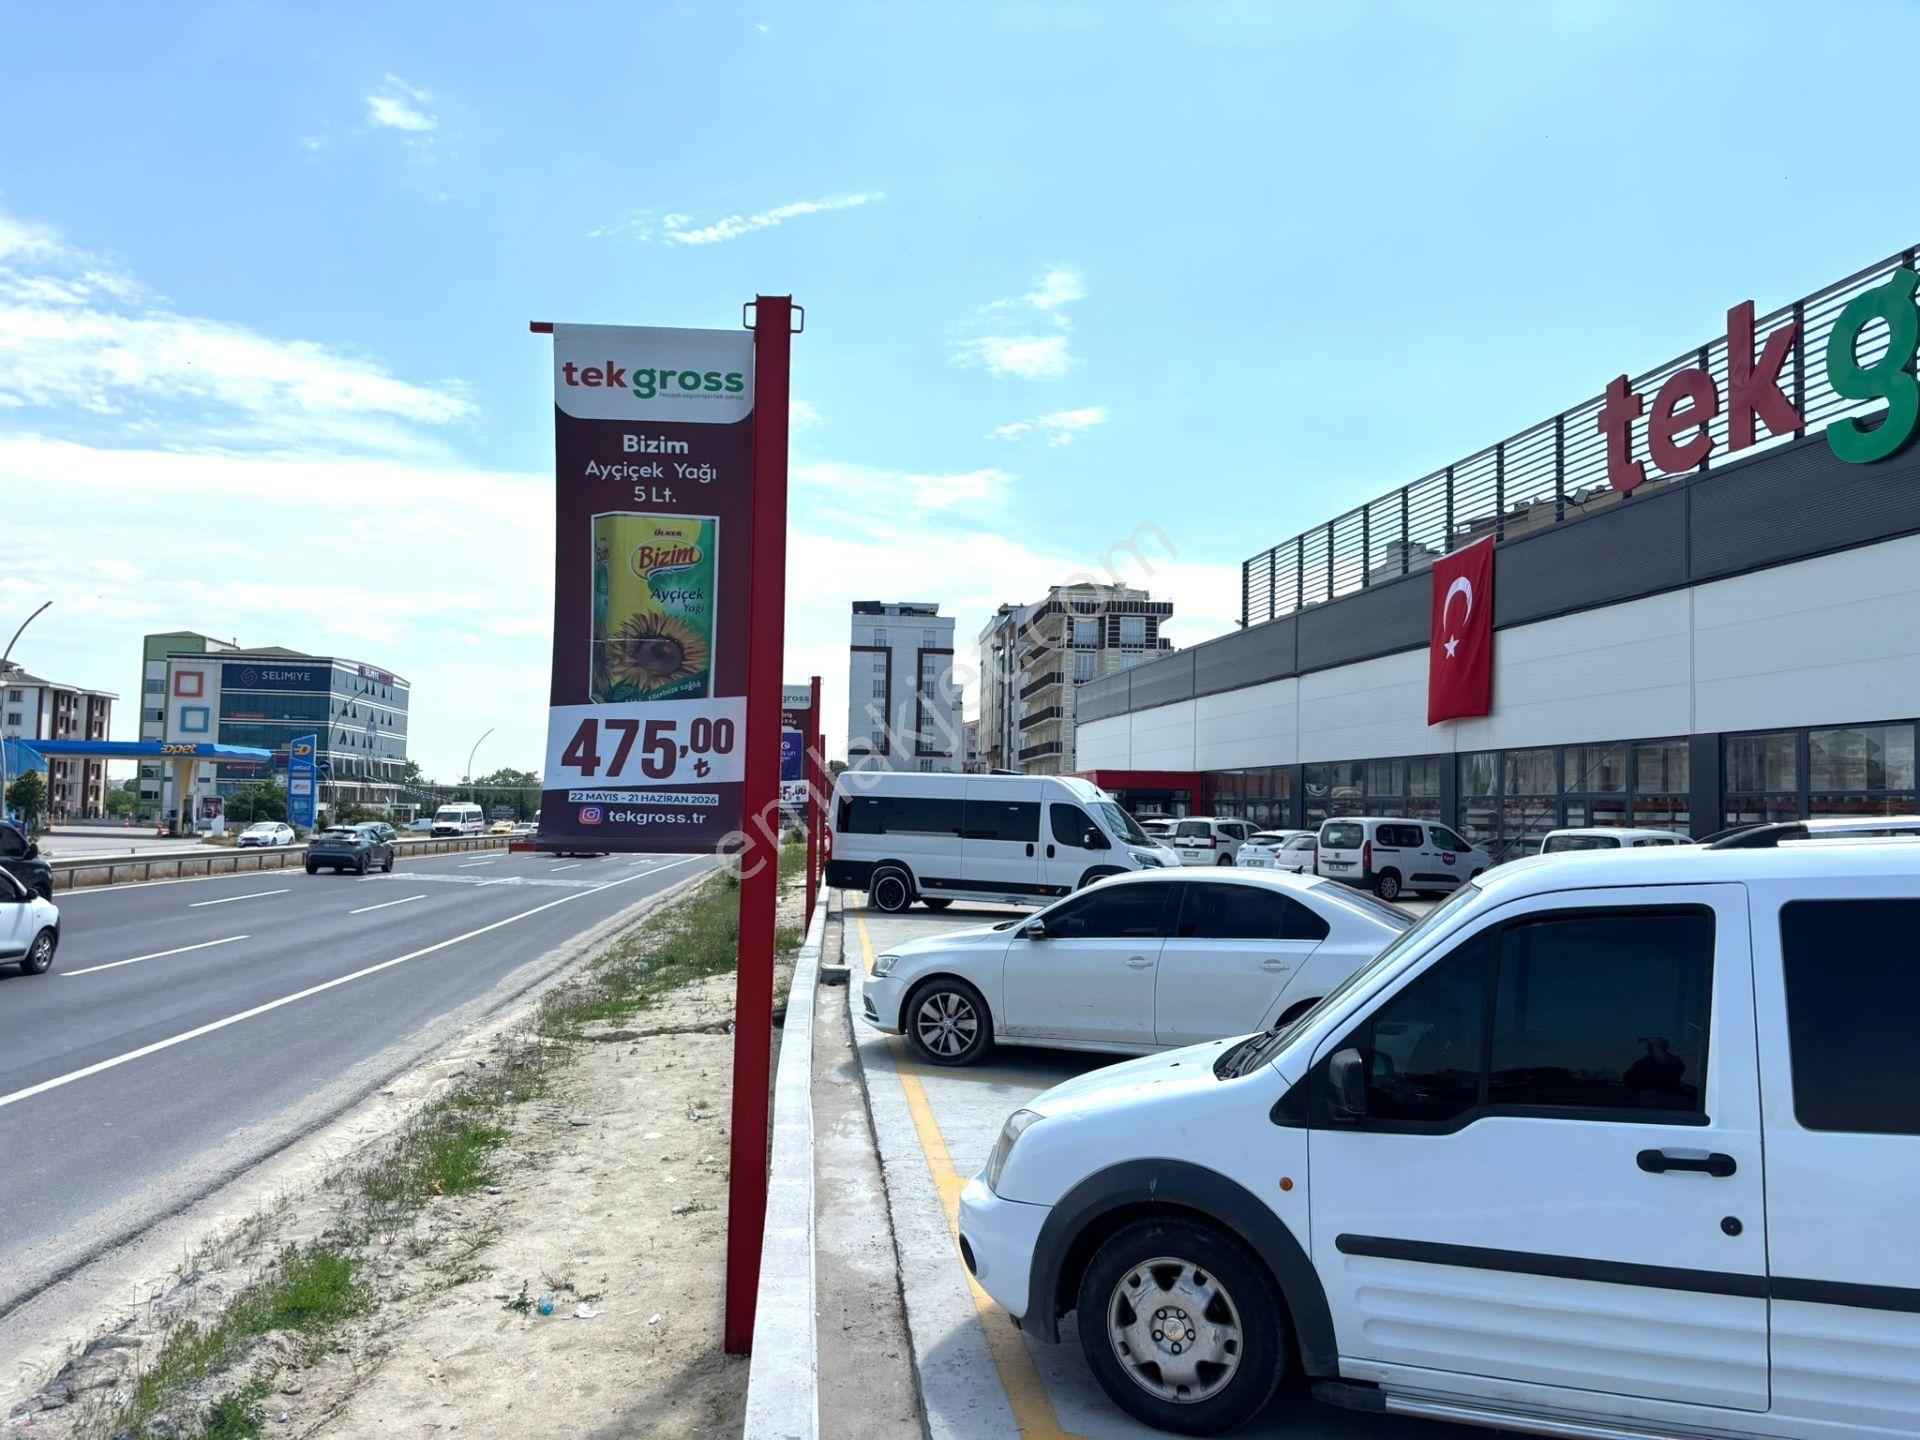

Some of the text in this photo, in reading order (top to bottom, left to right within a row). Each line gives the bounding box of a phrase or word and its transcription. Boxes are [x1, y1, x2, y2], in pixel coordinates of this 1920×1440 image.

[623, 434, 689, 454] Bizim
[585, 460, 717, 483] Ayçiçek Yağı
[634, 486, 677, 503] 5 Lt.
[639, 544, 698, 570] Bizim
[650, 587, 705, 603] Ayçiçek
[683, 603, 705, 614] Yağı
[161, 743, 197, 755] opet
[571, 792, 584, 801] 22
[586, 793, 619, 802] MAYIS
[628, 794, 638, 802] 21
[641, 794, 689, 804] HAZİRAN
[691, 796, 717, 804] 2026
[609, 810, 706, 826] tekgross.tr
